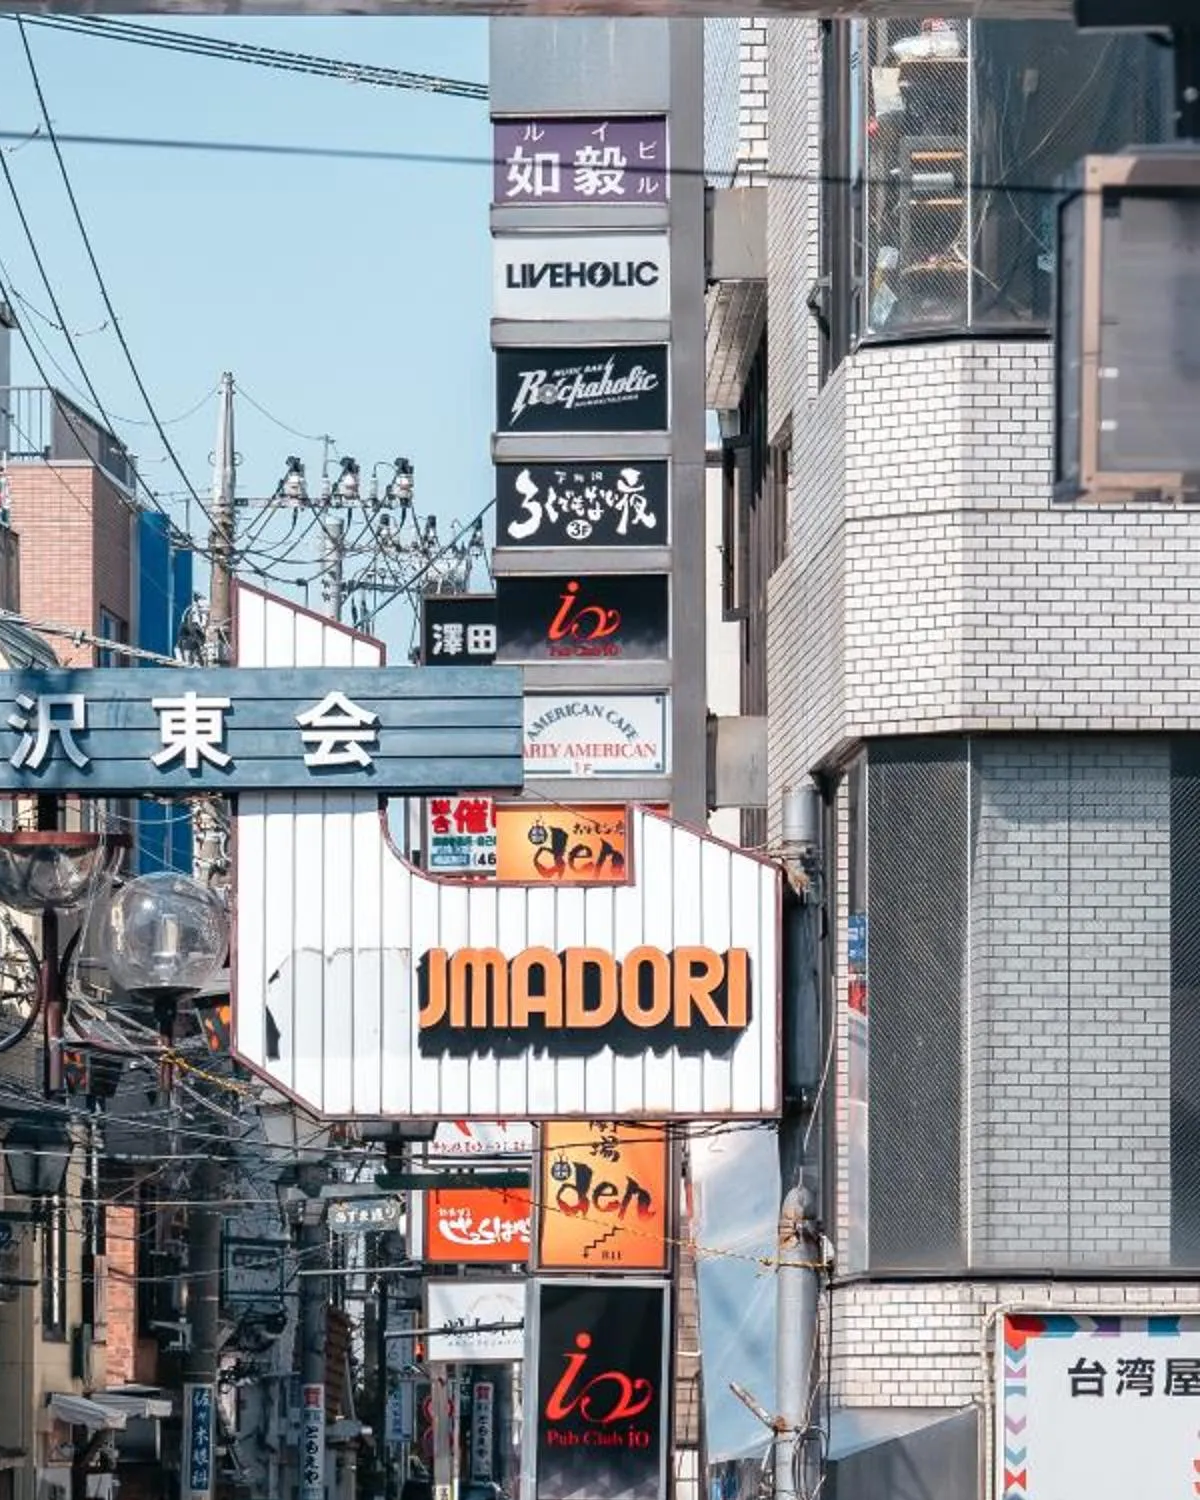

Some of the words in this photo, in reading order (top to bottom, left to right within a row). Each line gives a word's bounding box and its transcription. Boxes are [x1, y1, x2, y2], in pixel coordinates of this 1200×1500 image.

[506, 261, 659, 289] LIVEHOLIC
[509, 354, 659, 427] Rockaholic
[527, 702, 605, 741] AMERICAN
[605, 709, 639, 741] CAFE
[565, 743, 657, 758] AMERICAN
[556, 1161, 657, 1221] den
